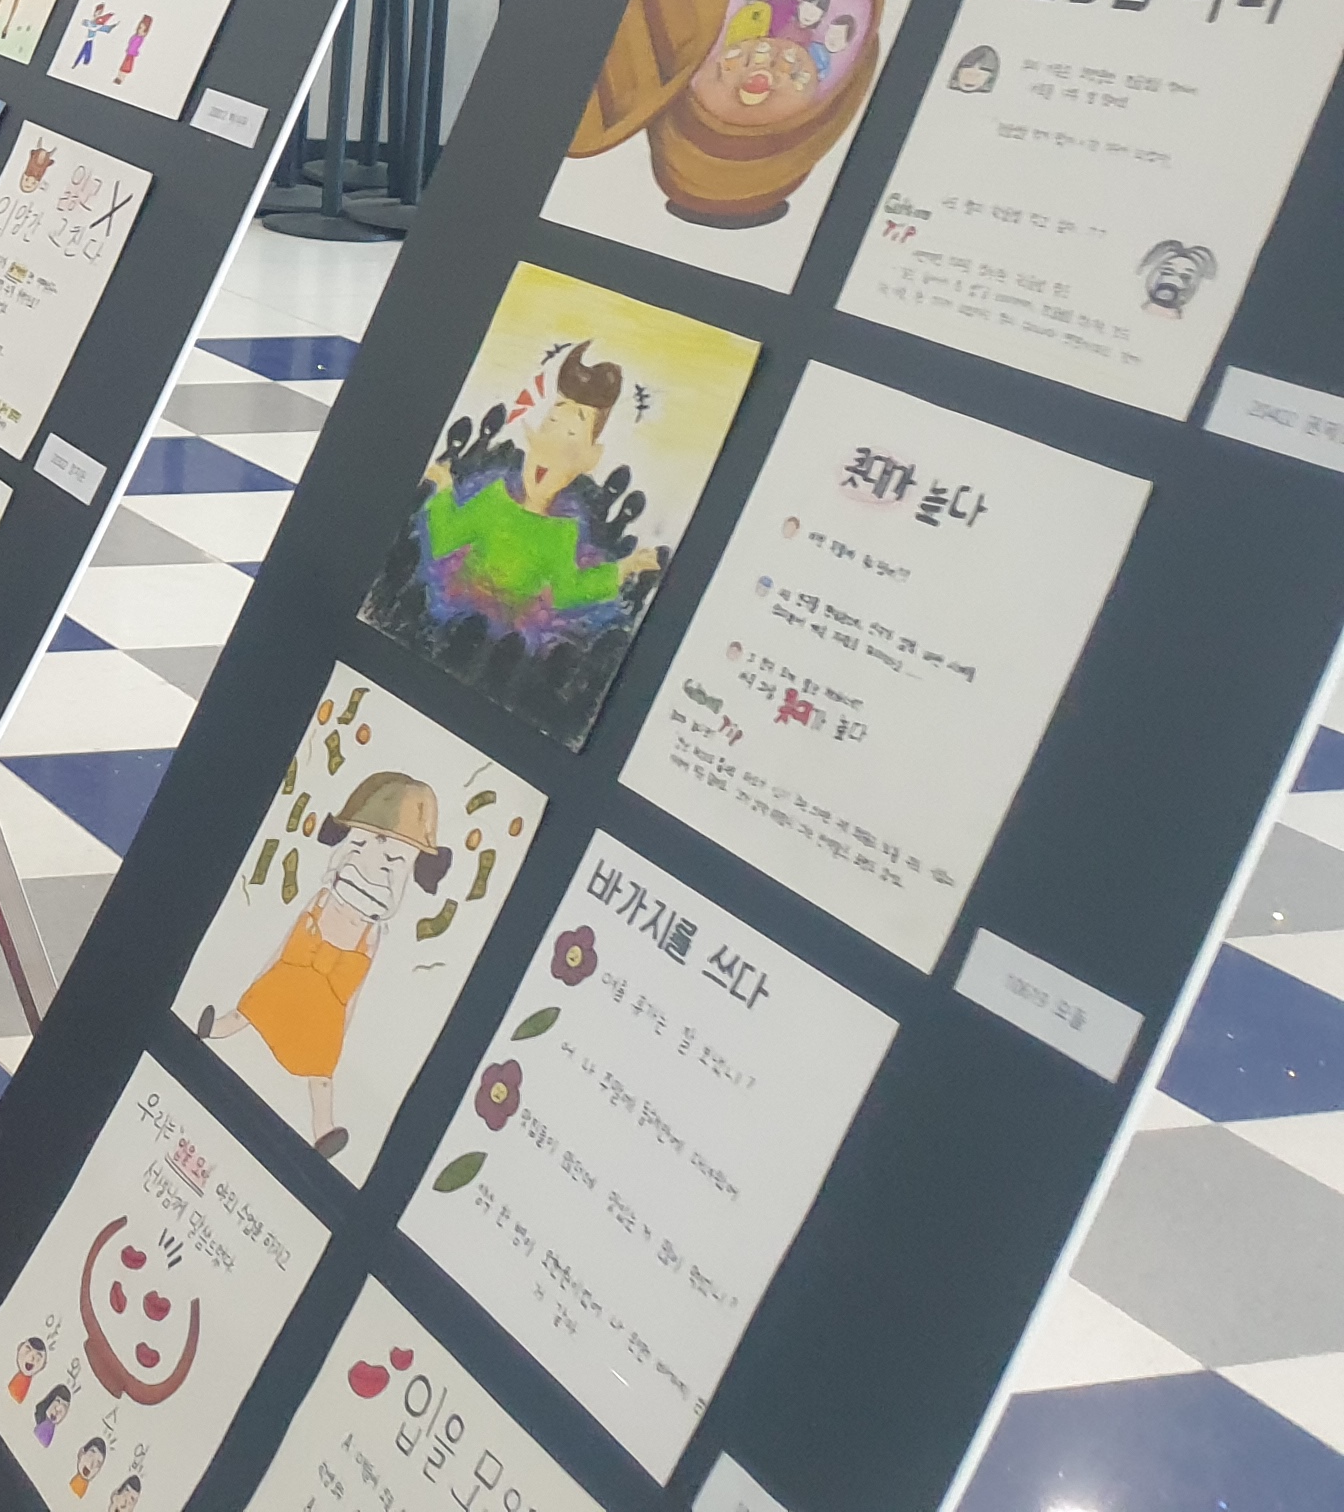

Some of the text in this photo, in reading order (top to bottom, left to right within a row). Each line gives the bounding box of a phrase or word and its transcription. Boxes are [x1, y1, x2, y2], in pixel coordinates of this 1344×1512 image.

[47, 217, 105, 266] 고친다
[915, 474, 990, 529] 높다
[586, 858, 770, 1010] 바가지를 쓰다
[137, 1093, 176, 1142] 우리는
[394, 1374, 466, 1485] 입을
